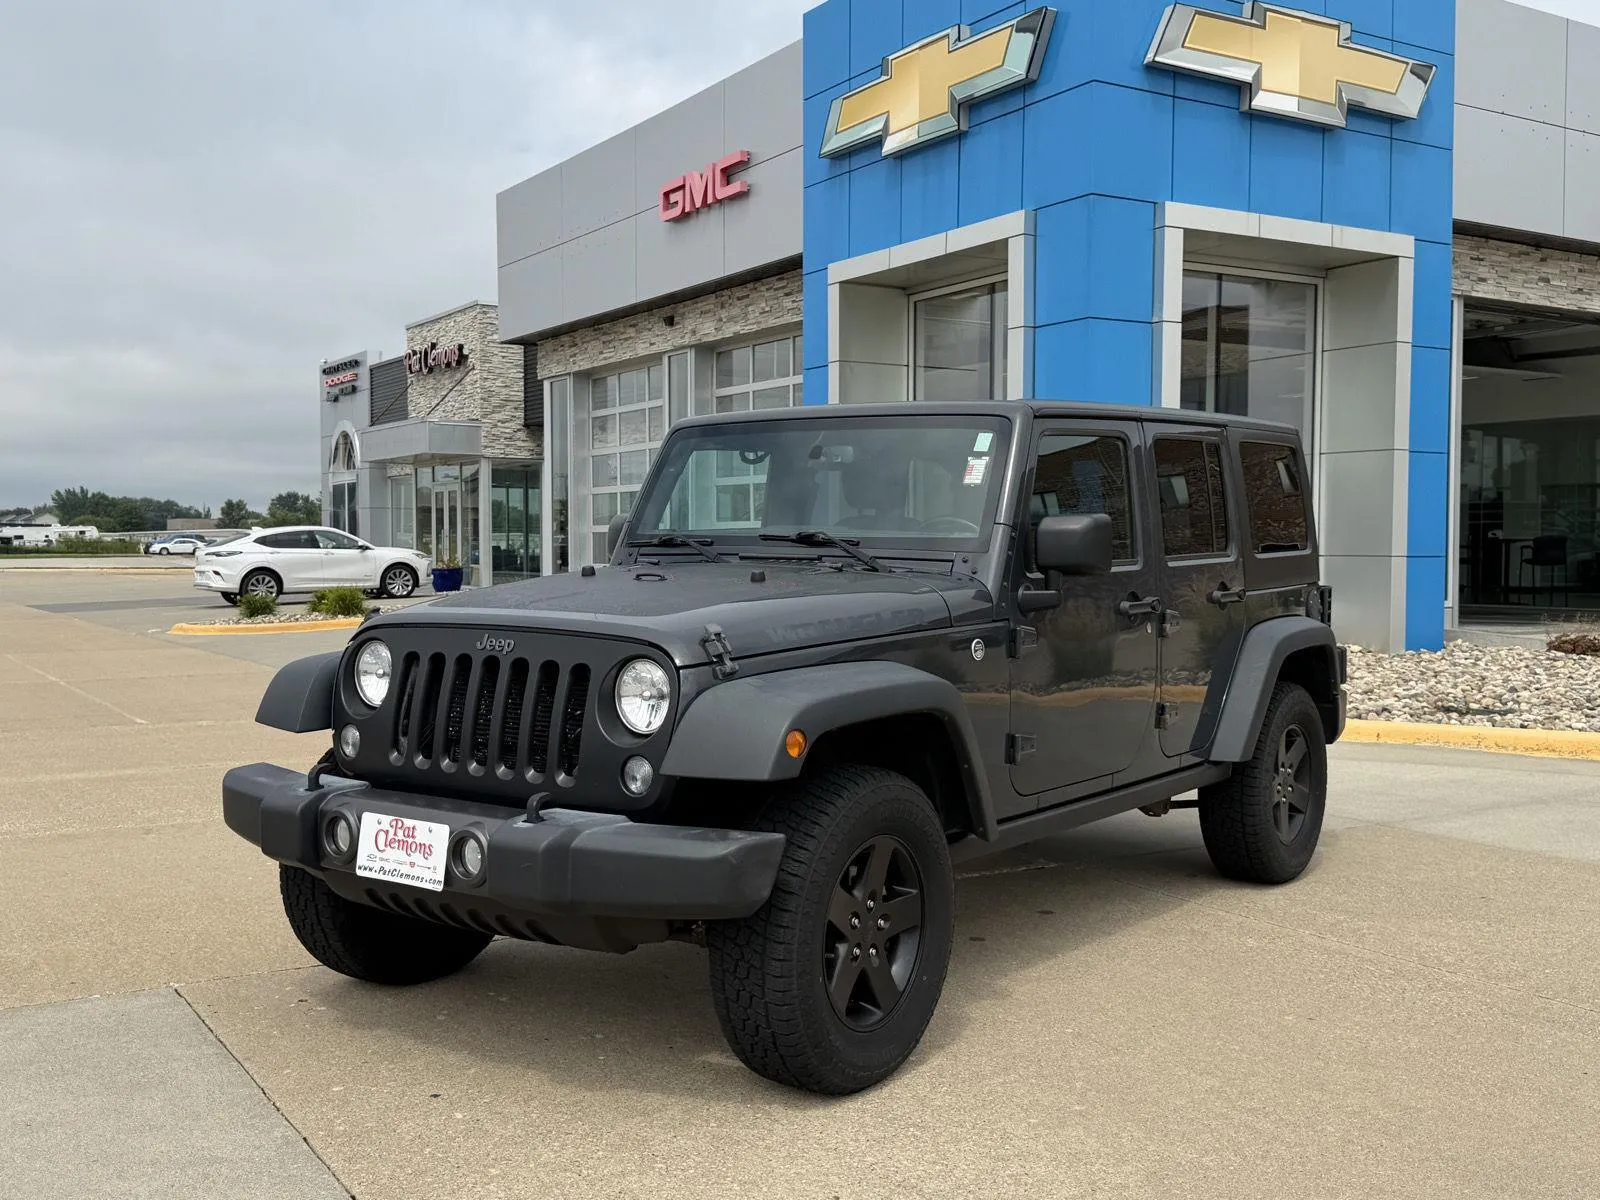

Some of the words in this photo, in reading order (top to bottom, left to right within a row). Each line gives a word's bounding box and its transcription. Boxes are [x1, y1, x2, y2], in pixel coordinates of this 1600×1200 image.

[659, 149, 750, 222] GMC
[403, 349, 421, 376] Pat
[421, 342, 461, 375] Clemons
[323, 371, 357, 387] DODGE
[475, 633, 515, 655] Jeep
[389, 818, 417, 840] Pat
[374, 829, 434, 860] Clemons
[357, 864, 442, 887] www.PatClemons.com
